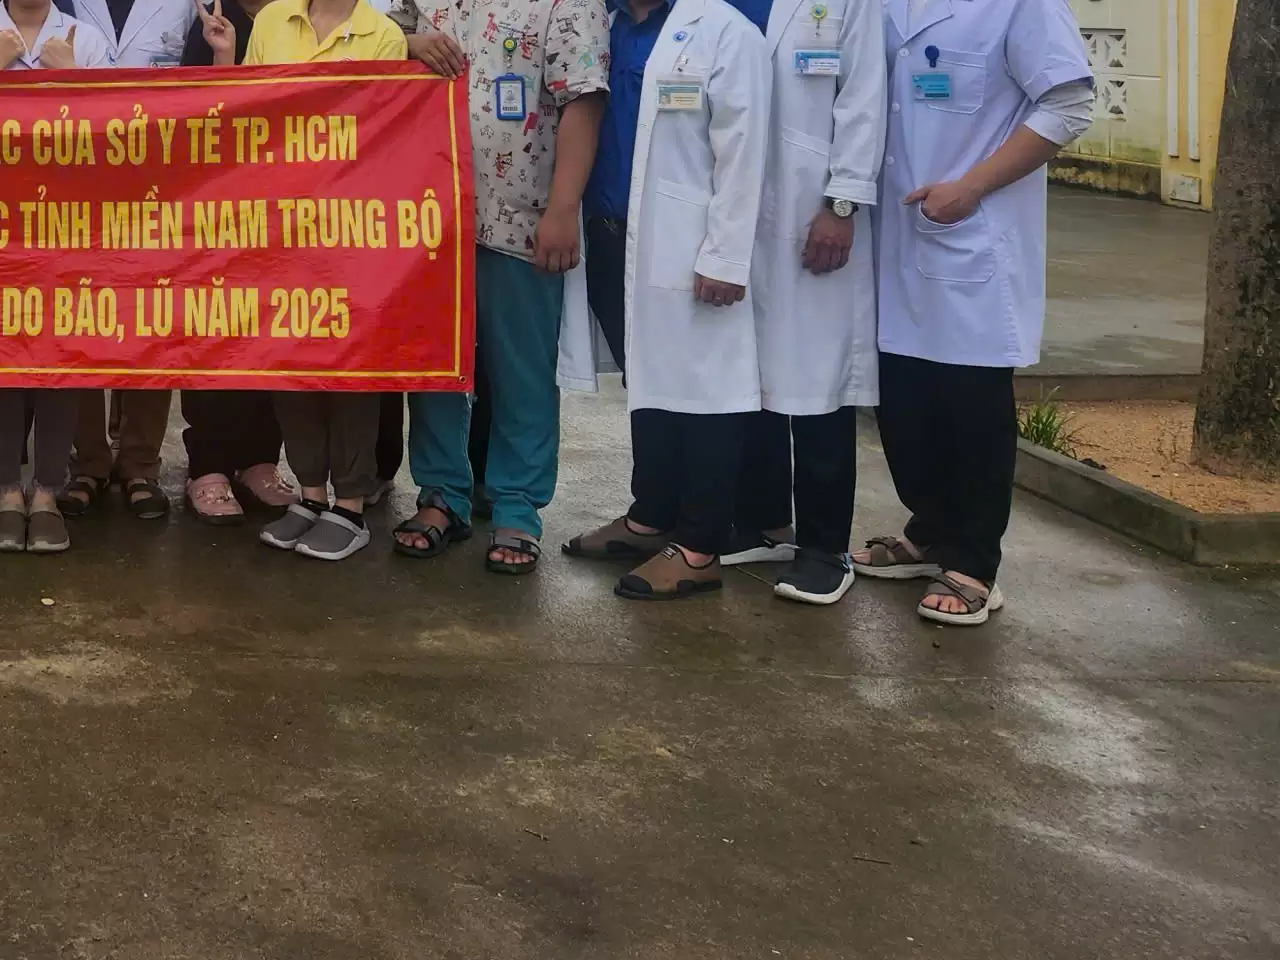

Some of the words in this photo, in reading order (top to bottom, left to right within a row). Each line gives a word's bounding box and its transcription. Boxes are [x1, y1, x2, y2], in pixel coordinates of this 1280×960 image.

[32, 106, 96, 165] CỦA
[106, 104, 148, 165] SỞ
[158, 119, 176, 163] Y
[187, 102, 224, 164] TẾ
[233, 118, 272, 163] TP.
[285, 115, 356, 162] HCM
[20, 186, 90, 248] TỈNH
[102, 185, 183, 249] MIỀN
[194, 200, 267, 248] NAM
[278, 199, 386, 248] TRUNG
[398, 188, 442, 260] BỘ
[2, 287, 42, 336] DO
[54, 277, 125, 343] BÃO,
[136, 277, 173, 337] LŨ
[184, 276, 259, 337] NĂM
[271, 288, 349, 337] 2025
